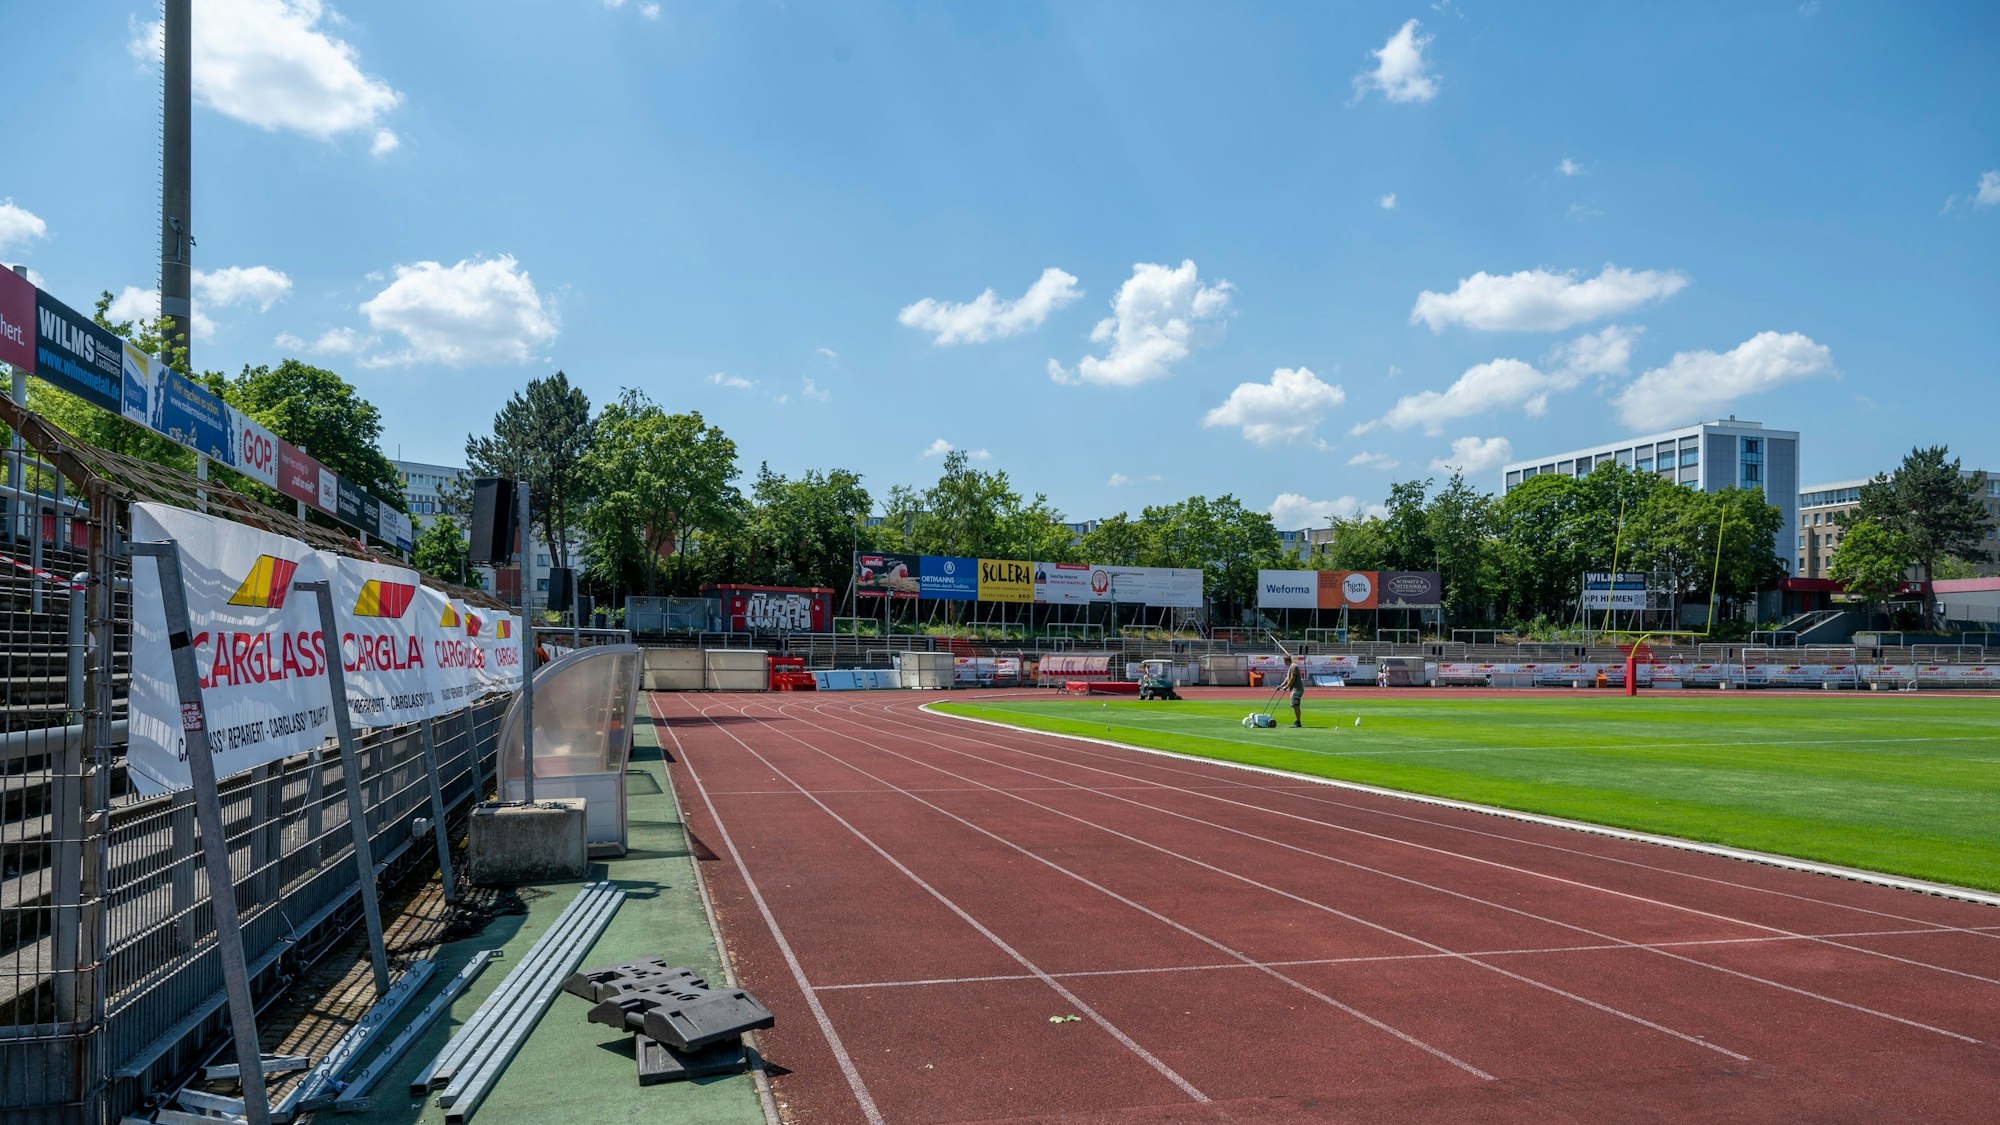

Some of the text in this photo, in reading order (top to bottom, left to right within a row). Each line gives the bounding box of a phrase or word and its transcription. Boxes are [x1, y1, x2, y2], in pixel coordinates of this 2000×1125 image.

[39, 305, 95, 363] WILMS
[39, 346, 120, 400] www.wilmsmetall.de
[921, 576, 955, 584] ORTMANNS
[982, 563, 1030, 584] SOLERA
[1586, 573, 1625, 582] WILMS
[1266, 584, 1310, 594] Weforma
[192, 631, 326, 690] CARGLASS
[343, 632, 424, 672] CARGLA
